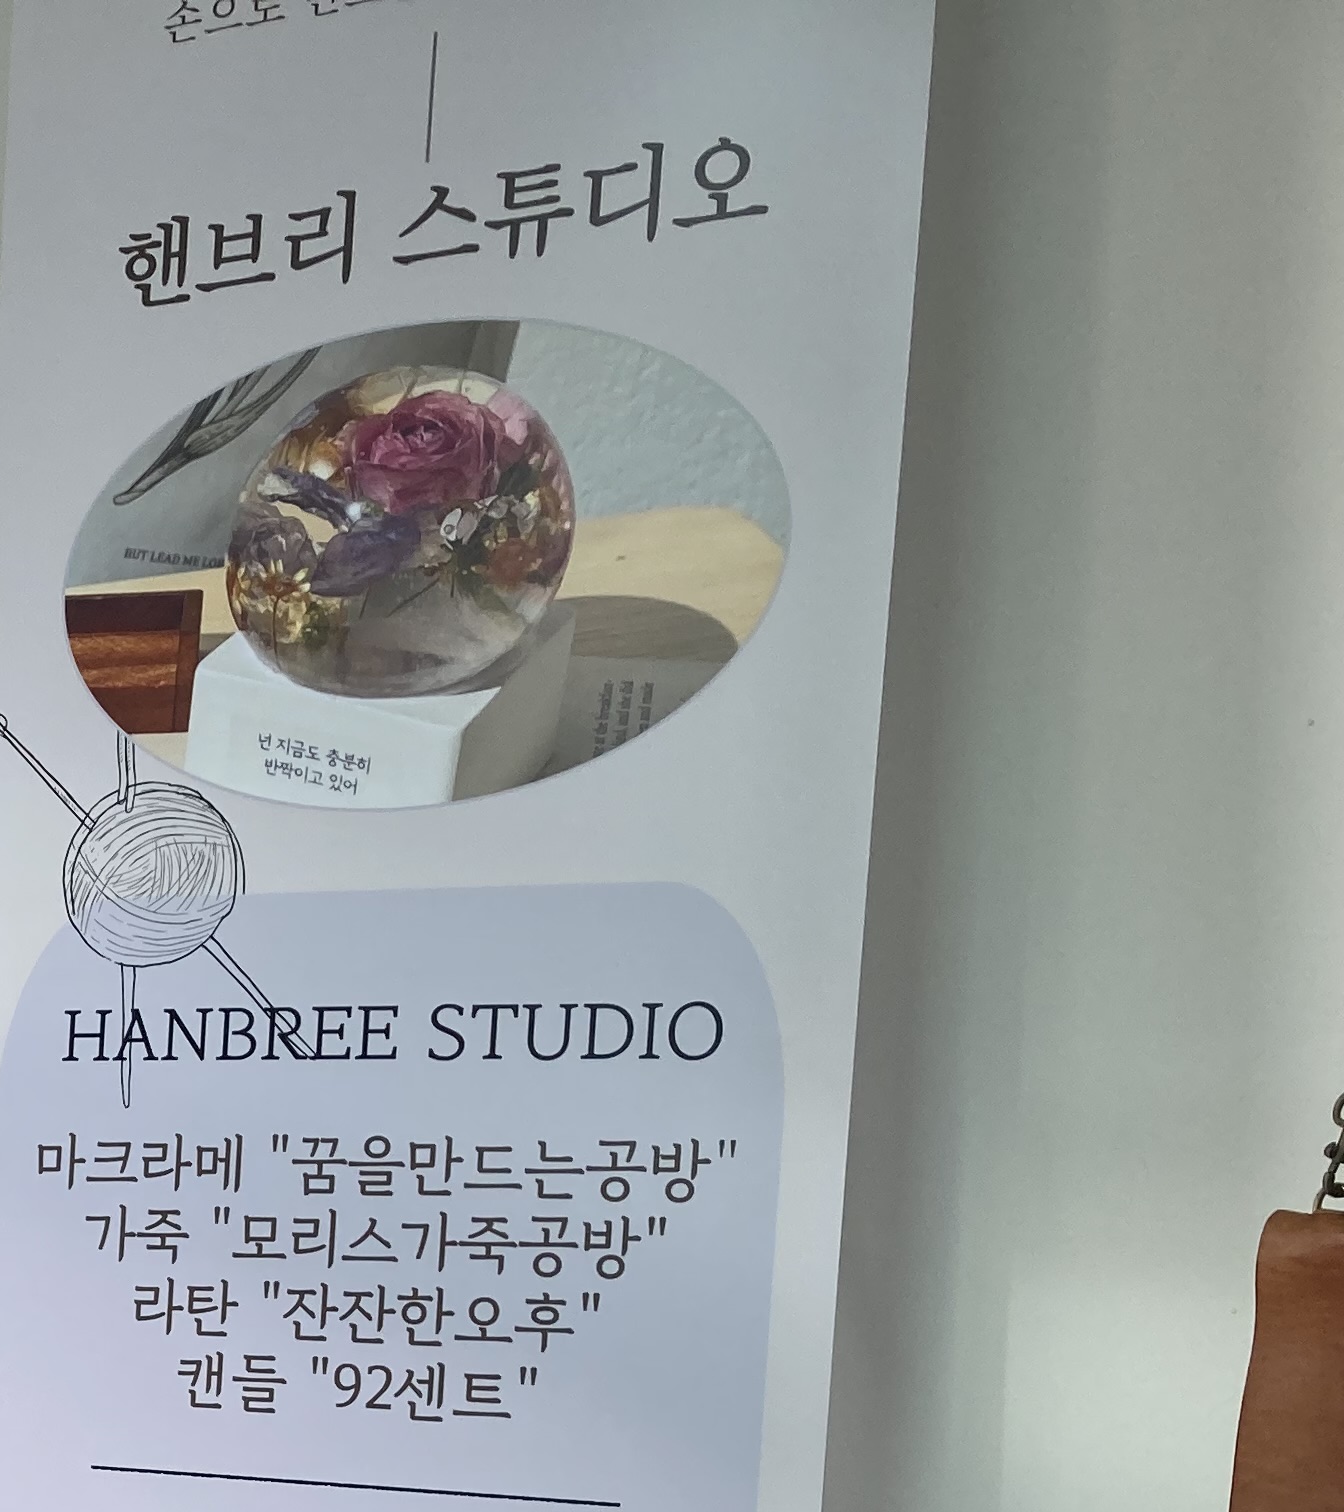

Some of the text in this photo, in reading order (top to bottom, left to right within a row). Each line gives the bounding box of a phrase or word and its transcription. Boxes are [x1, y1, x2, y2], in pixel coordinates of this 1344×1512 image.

[118, 135, 770, 307] 핸브리 스튜디오
[150, 551, 181, 565] LEAD
[258, 732, 371, 775] 넌 지금도 충분히
[264, 758, 358, 795] 반짝이고 있어
[62, 1000, 725, 1062] HANBREE STUDIO
[36, 1131, 739, 1204] 마크라메 "꿈을만드는공방"
[85, 1204, 668, 1280] 가죽 "모리스가죽공방"
[133, 1278, 601, 1353] 라탄 "잔잔한오후"
[177, 1352, 539, 1422] 캔들 "92센트"
